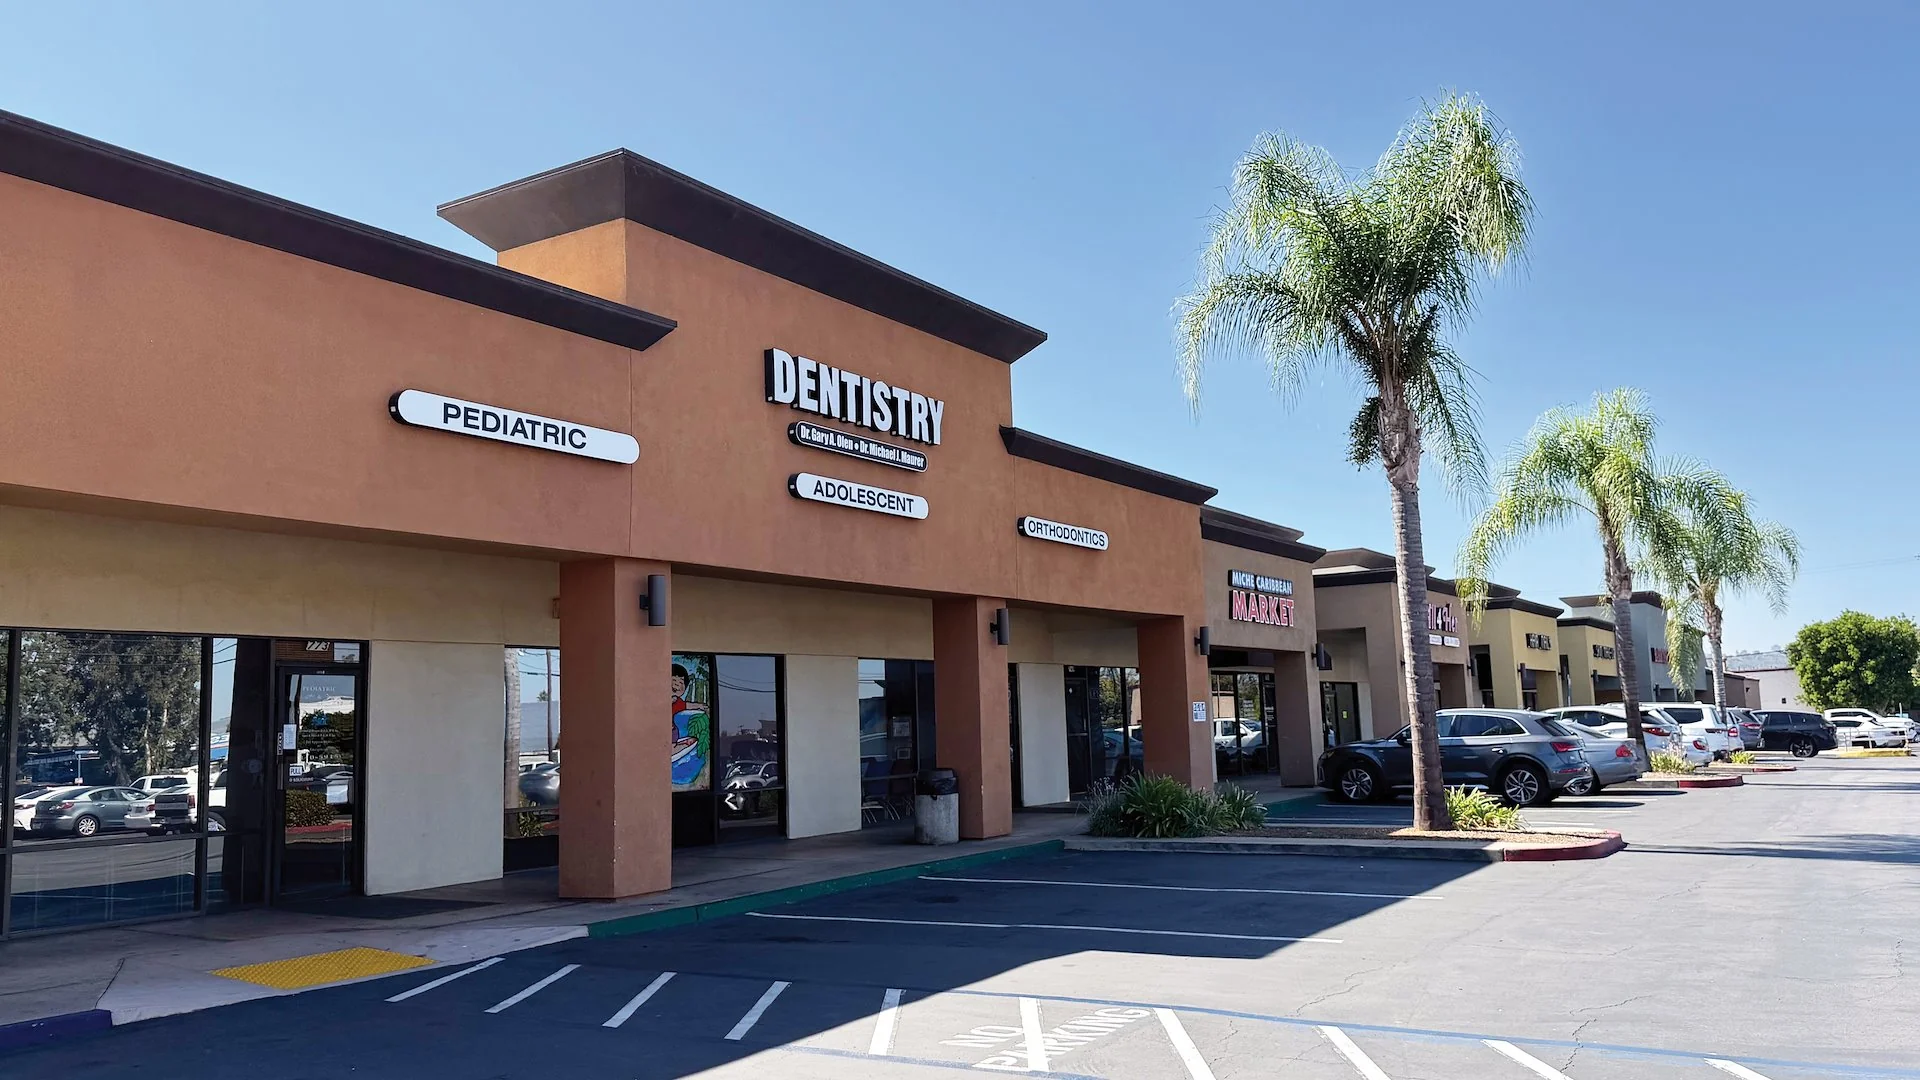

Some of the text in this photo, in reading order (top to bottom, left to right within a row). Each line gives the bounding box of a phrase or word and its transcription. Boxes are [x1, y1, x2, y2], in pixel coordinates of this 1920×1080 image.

[772, 347, 945, 446] DENTISTRY
[443, 402, 587, 450] PEDIATRIC
[800, 425, 811, 440] Dr.
[811, 430, 829, 446] Gary
[829, 434, 836, 447] A.
[836, 436, 853, 450] Olen
[859, 440, 870, 454] Dr.
[869, 444, 896, 460] Michael
[901, 450, 925, 468] Maurer
[813, 480, 914, 513] ADOLESCENT
[1028, 520, 1105, 547] ORTHODONTICS
[1232, 571, 1293, 595] MICHE CARIBBEAN
[1232, 590, 1294, 627] MARKET
[938, 1025, 1023, 1048] NO
[972, 1008, 1151, 1071] PARKING
